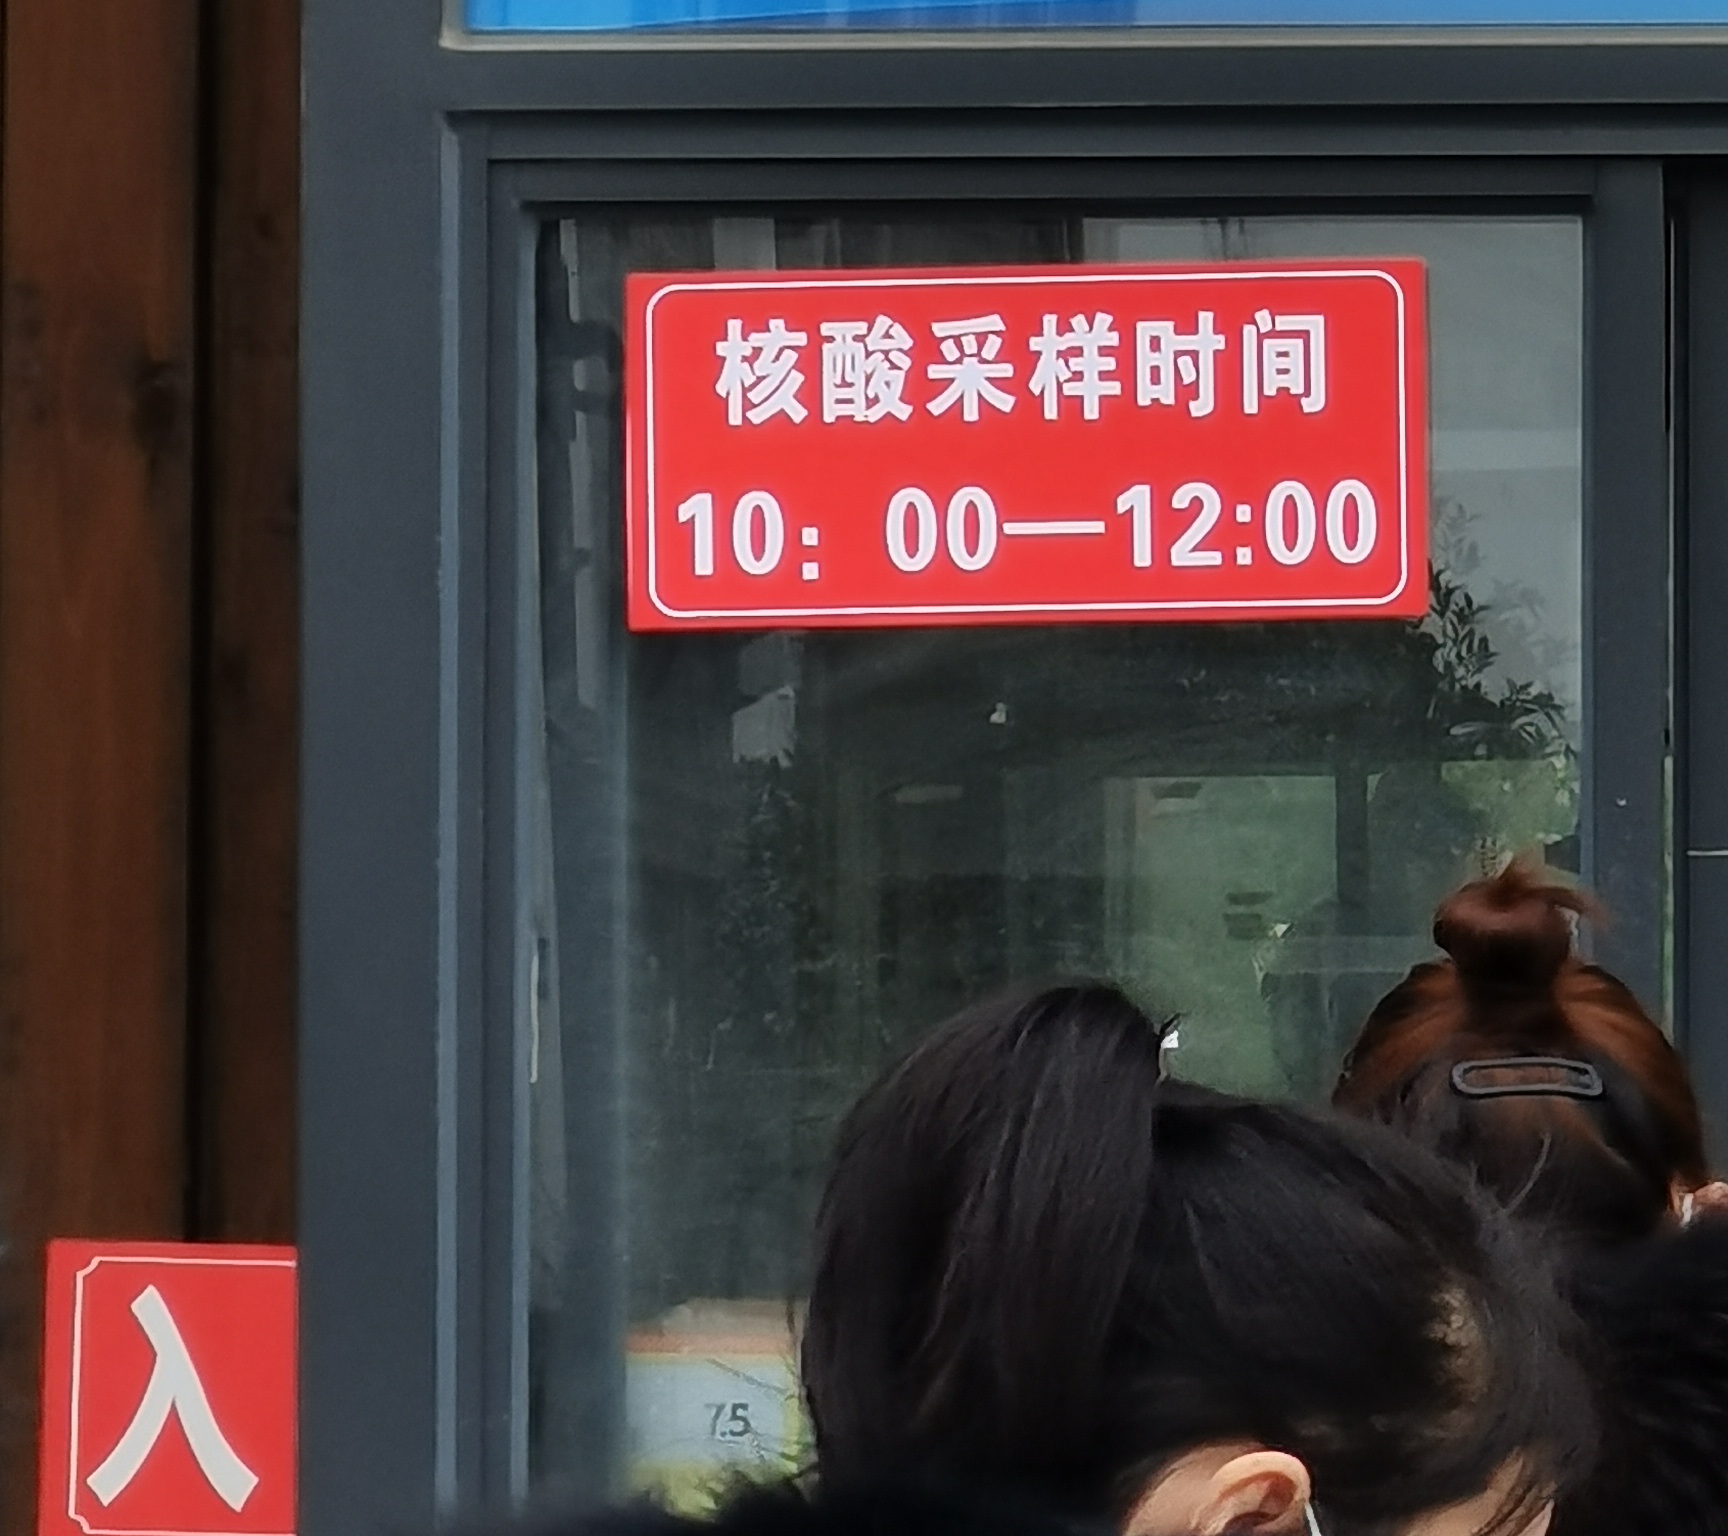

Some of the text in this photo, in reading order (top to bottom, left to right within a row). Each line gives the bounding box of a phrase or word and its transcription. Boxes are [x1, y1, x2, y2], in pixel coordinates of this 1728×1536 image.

[714, 309, 1327, 427] 核酸采样时间
[86, 1284, 260, 1513] 入
